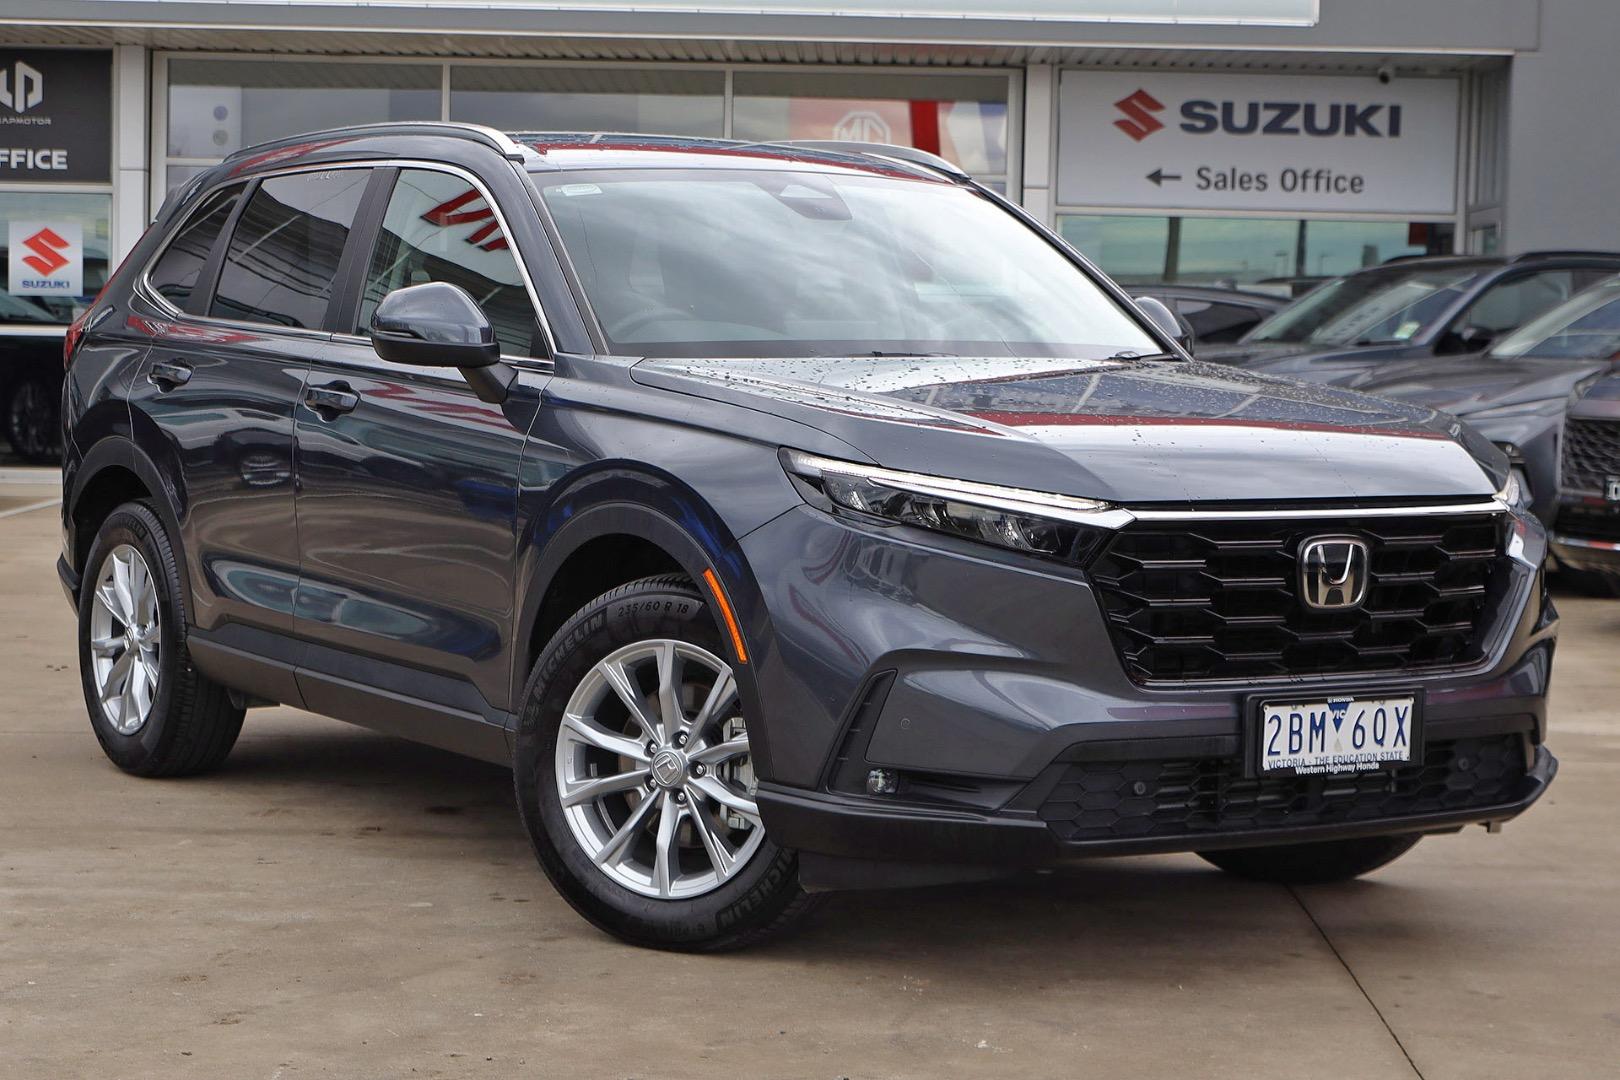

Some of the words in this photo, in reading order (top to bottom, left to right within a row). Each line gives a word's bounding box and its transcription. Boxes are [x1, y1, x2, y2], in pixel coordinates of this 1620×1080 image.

[0, 117, 52, 125] APMOTOR
[1179, 100, 1402, 138] SUZUKI
[1196, 166, 1268, 192] Sales
[1280, 168, 1365, 193] Office
[21, 280, 70, 289] SUZUKI
[617, 600, 660, 617] 235/60
[664, 601, 672, 612] R
[676, 603, 690, 614] 18
[533, 611, 608, 701] MICHELIN
[1332, 709, 1346, 719] VIC
[1267, 711, 1327, 757] 2BM
[1351, 705, 1409, 750] 6QX
[1268, 758, 1306, 769] VICTORIA
[1315, 756, 1331, 766] THE
[1333, 752, 1378, 764] EDUCATION
[1380, 750, 1403, 761] STATE
[1295, 765, 1325, 775] Western
[1326, 763, 1356, 775] Highway
[1356, 761, 1380, 770] Honda
